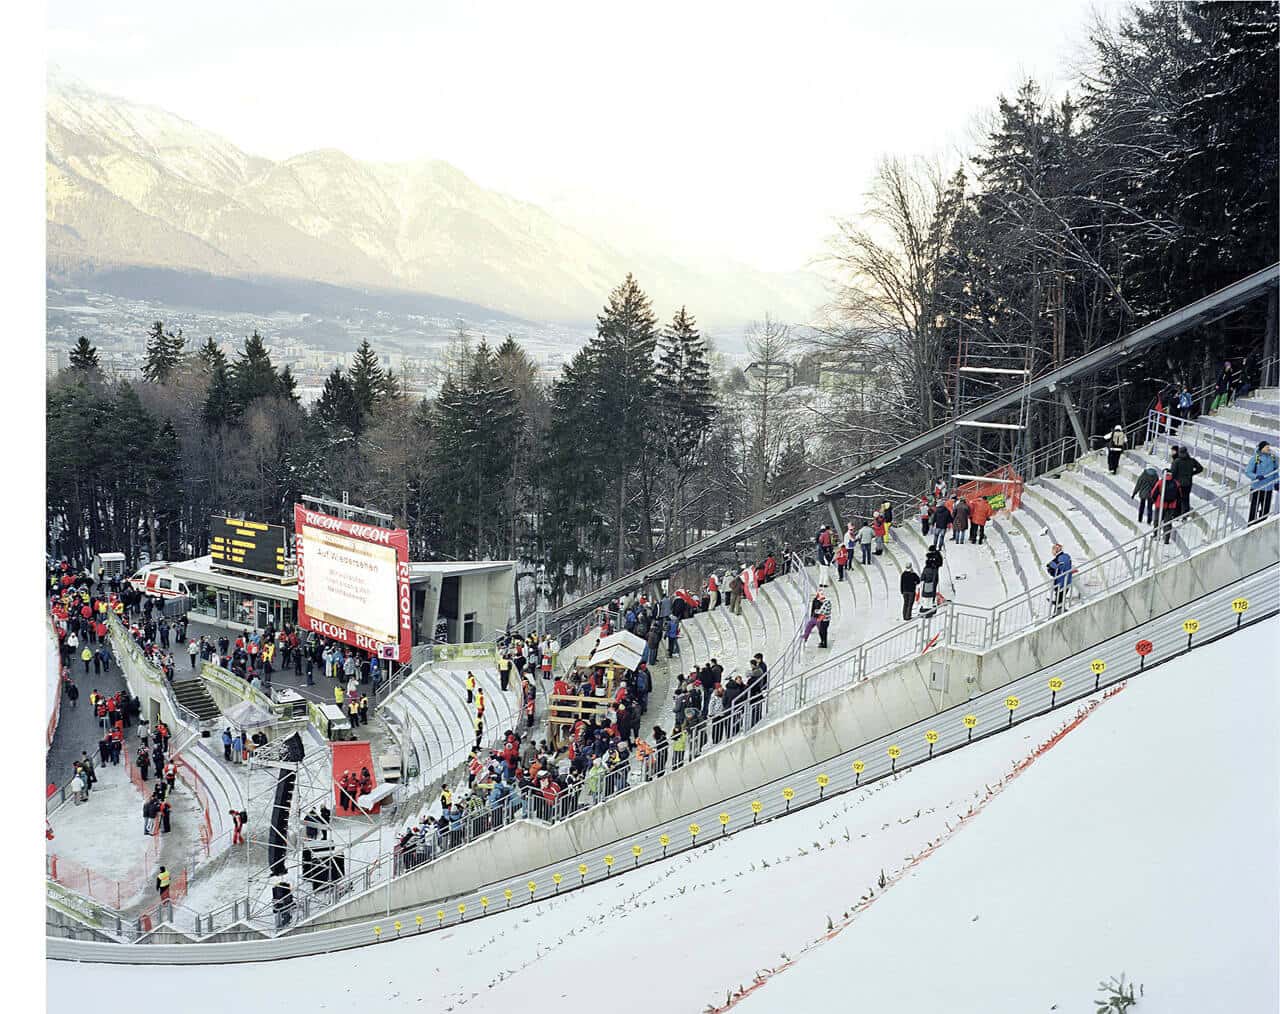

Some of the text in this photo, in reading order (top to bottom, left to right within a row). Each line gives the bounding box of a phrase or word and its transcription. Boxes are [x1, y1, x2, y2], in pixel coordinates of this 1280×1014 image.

[305, 512, 390, 544] RICOH RICOH
[398, 560, 411, 630] RICOH
[1233, 601, 1248, 610] 118
[310, 618, 383, 653] RICOH RICO
[1184, 621, 1198, 630] 119
[1092, 662, 1105, 671] 121
